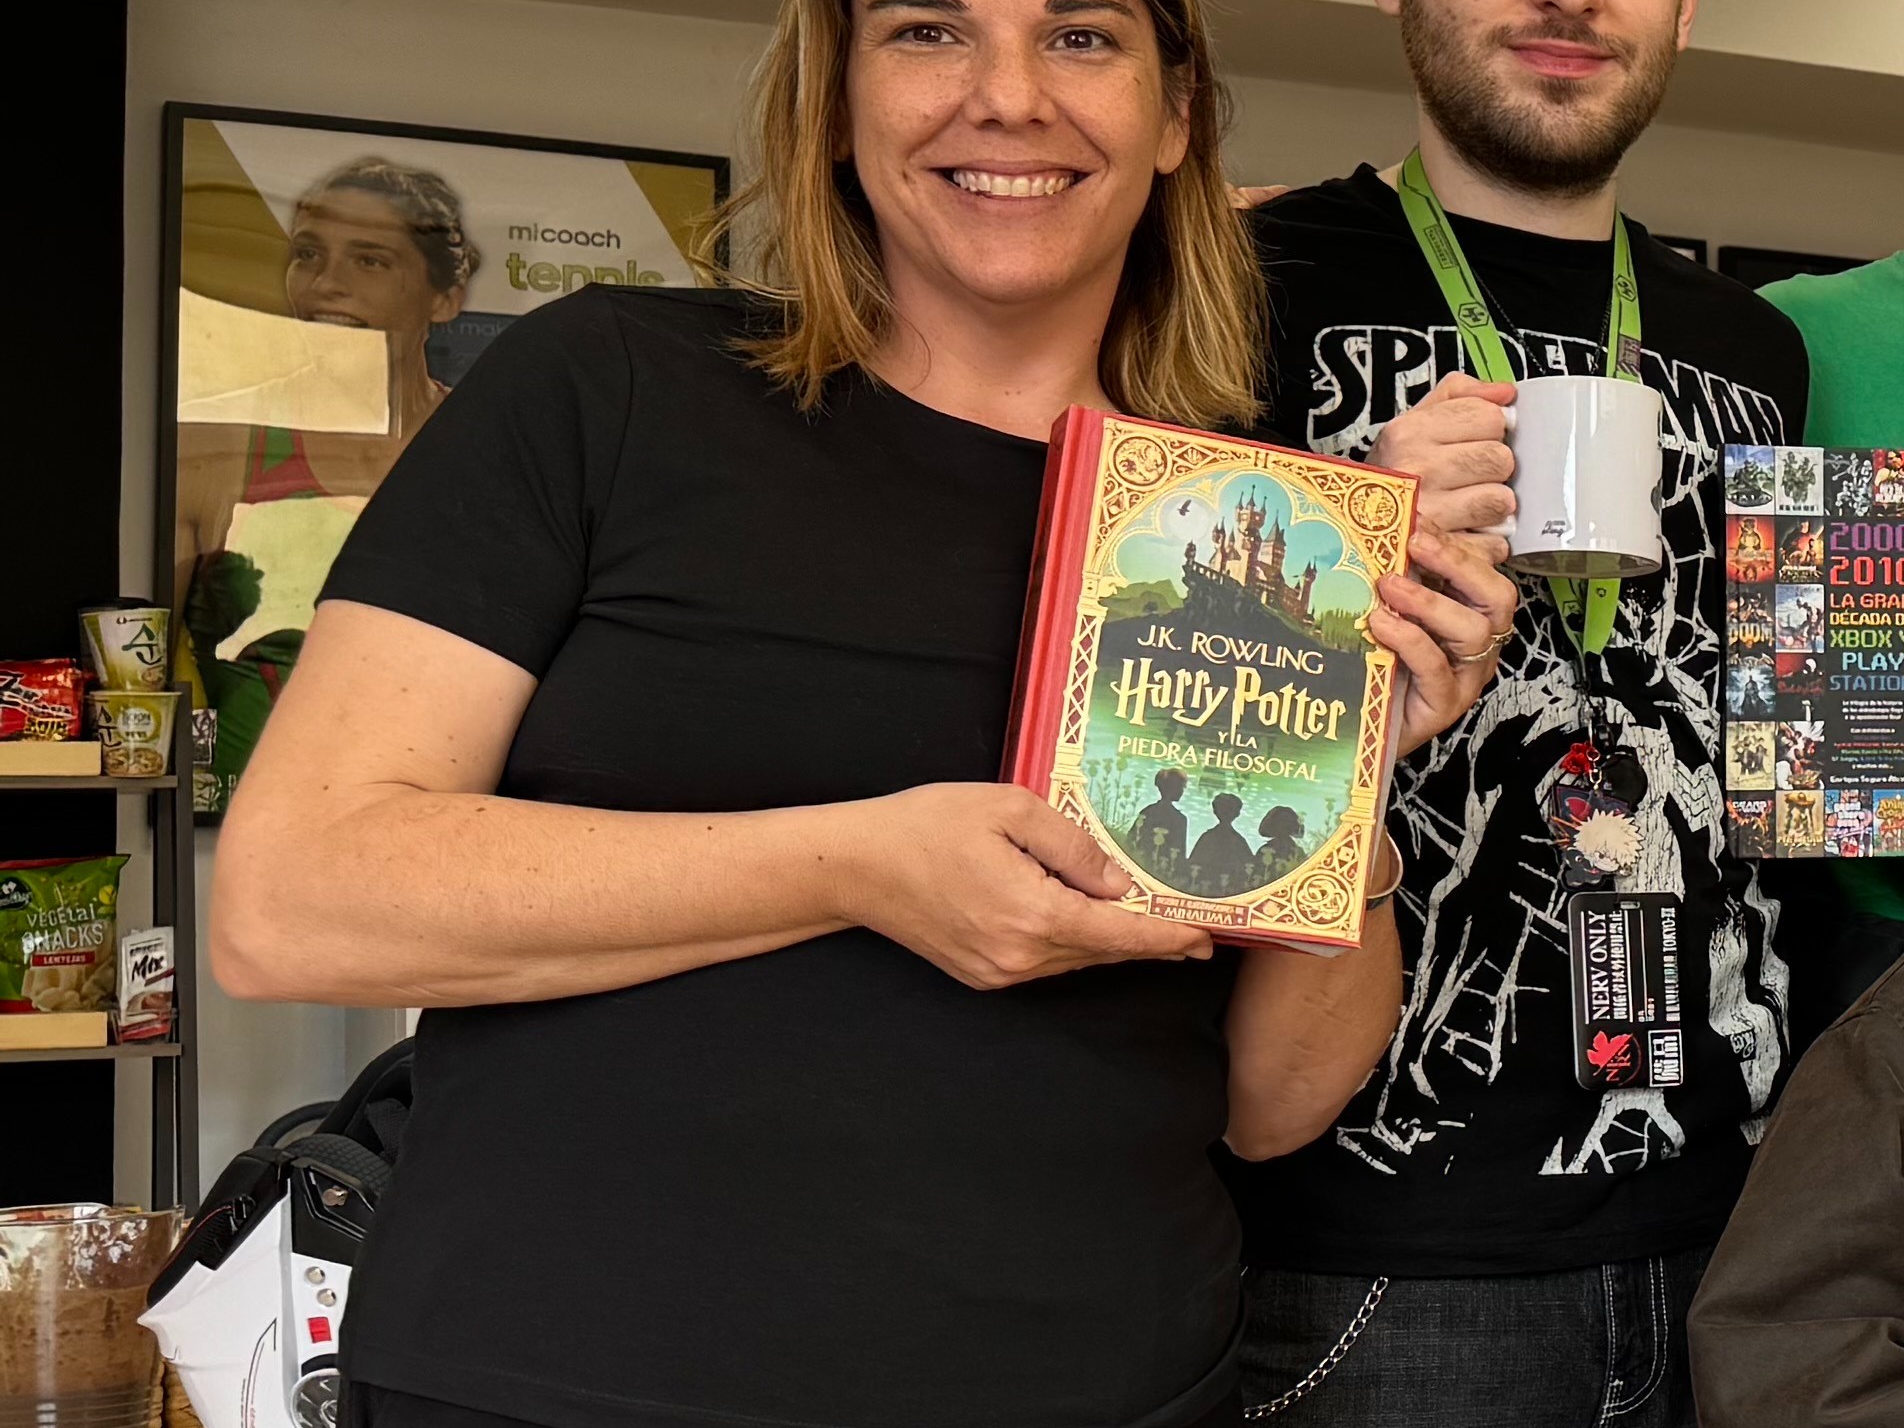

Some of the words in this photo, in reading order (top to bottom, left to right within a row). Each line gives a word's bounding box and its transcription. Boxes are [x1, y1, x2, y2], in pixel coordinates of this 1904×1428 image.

[1830, 593, 1855, 608] LA
[1830, 609, 1892, 625] DÉCADA
[1137, 625, 1182, 651] J.K.
[1191, 631, 1324, 675] ROWLING
[1830, 629, 1893, 648] XBOX
[1842, 652, 1904, 671] PLAY
[1110, 657, 1229, 727] Harry
[1230, 666, 1347, 746] Potter
[1218, 731, 1229, 744] Y
[1235, 733, 1258, 750] LA
[1117, 734, 1198, 769] PIEDRA
[1204, 748, 1322, 783] FILOSOFAL
[22, 923, 105, 953] SNACKS
[1588, 910, 1609, 963] ONLY
[1590, 967, 1611, 1020] NERV
